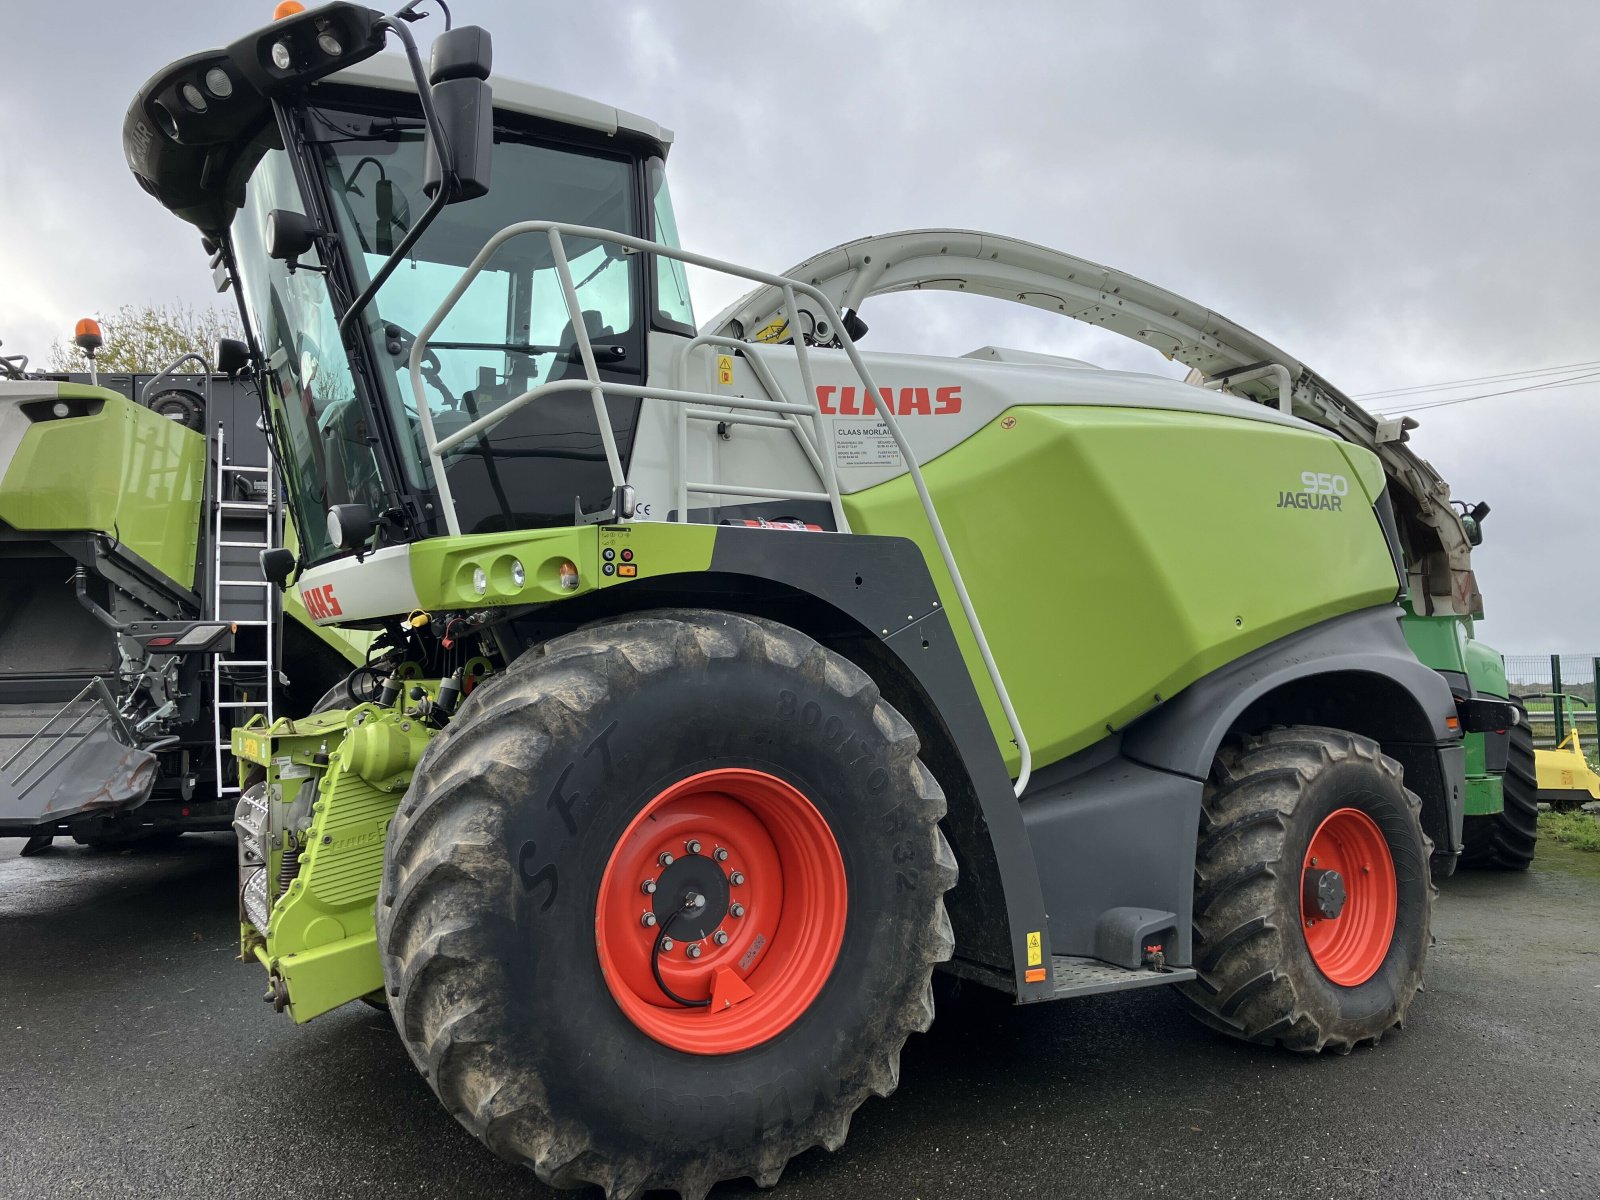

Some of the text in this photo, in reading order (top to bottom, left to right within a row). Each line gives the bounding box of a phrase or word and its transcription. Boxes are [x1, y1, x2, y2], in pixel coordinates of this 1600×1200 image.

[816, 386, 962, 415] CLAAS
[1301, 471, 1348, 496] 950
[635, 502, 651, 516] CE
[1276, 491, 1342, 512] JAGUAR
[303, 584, 342, 619] AAS
